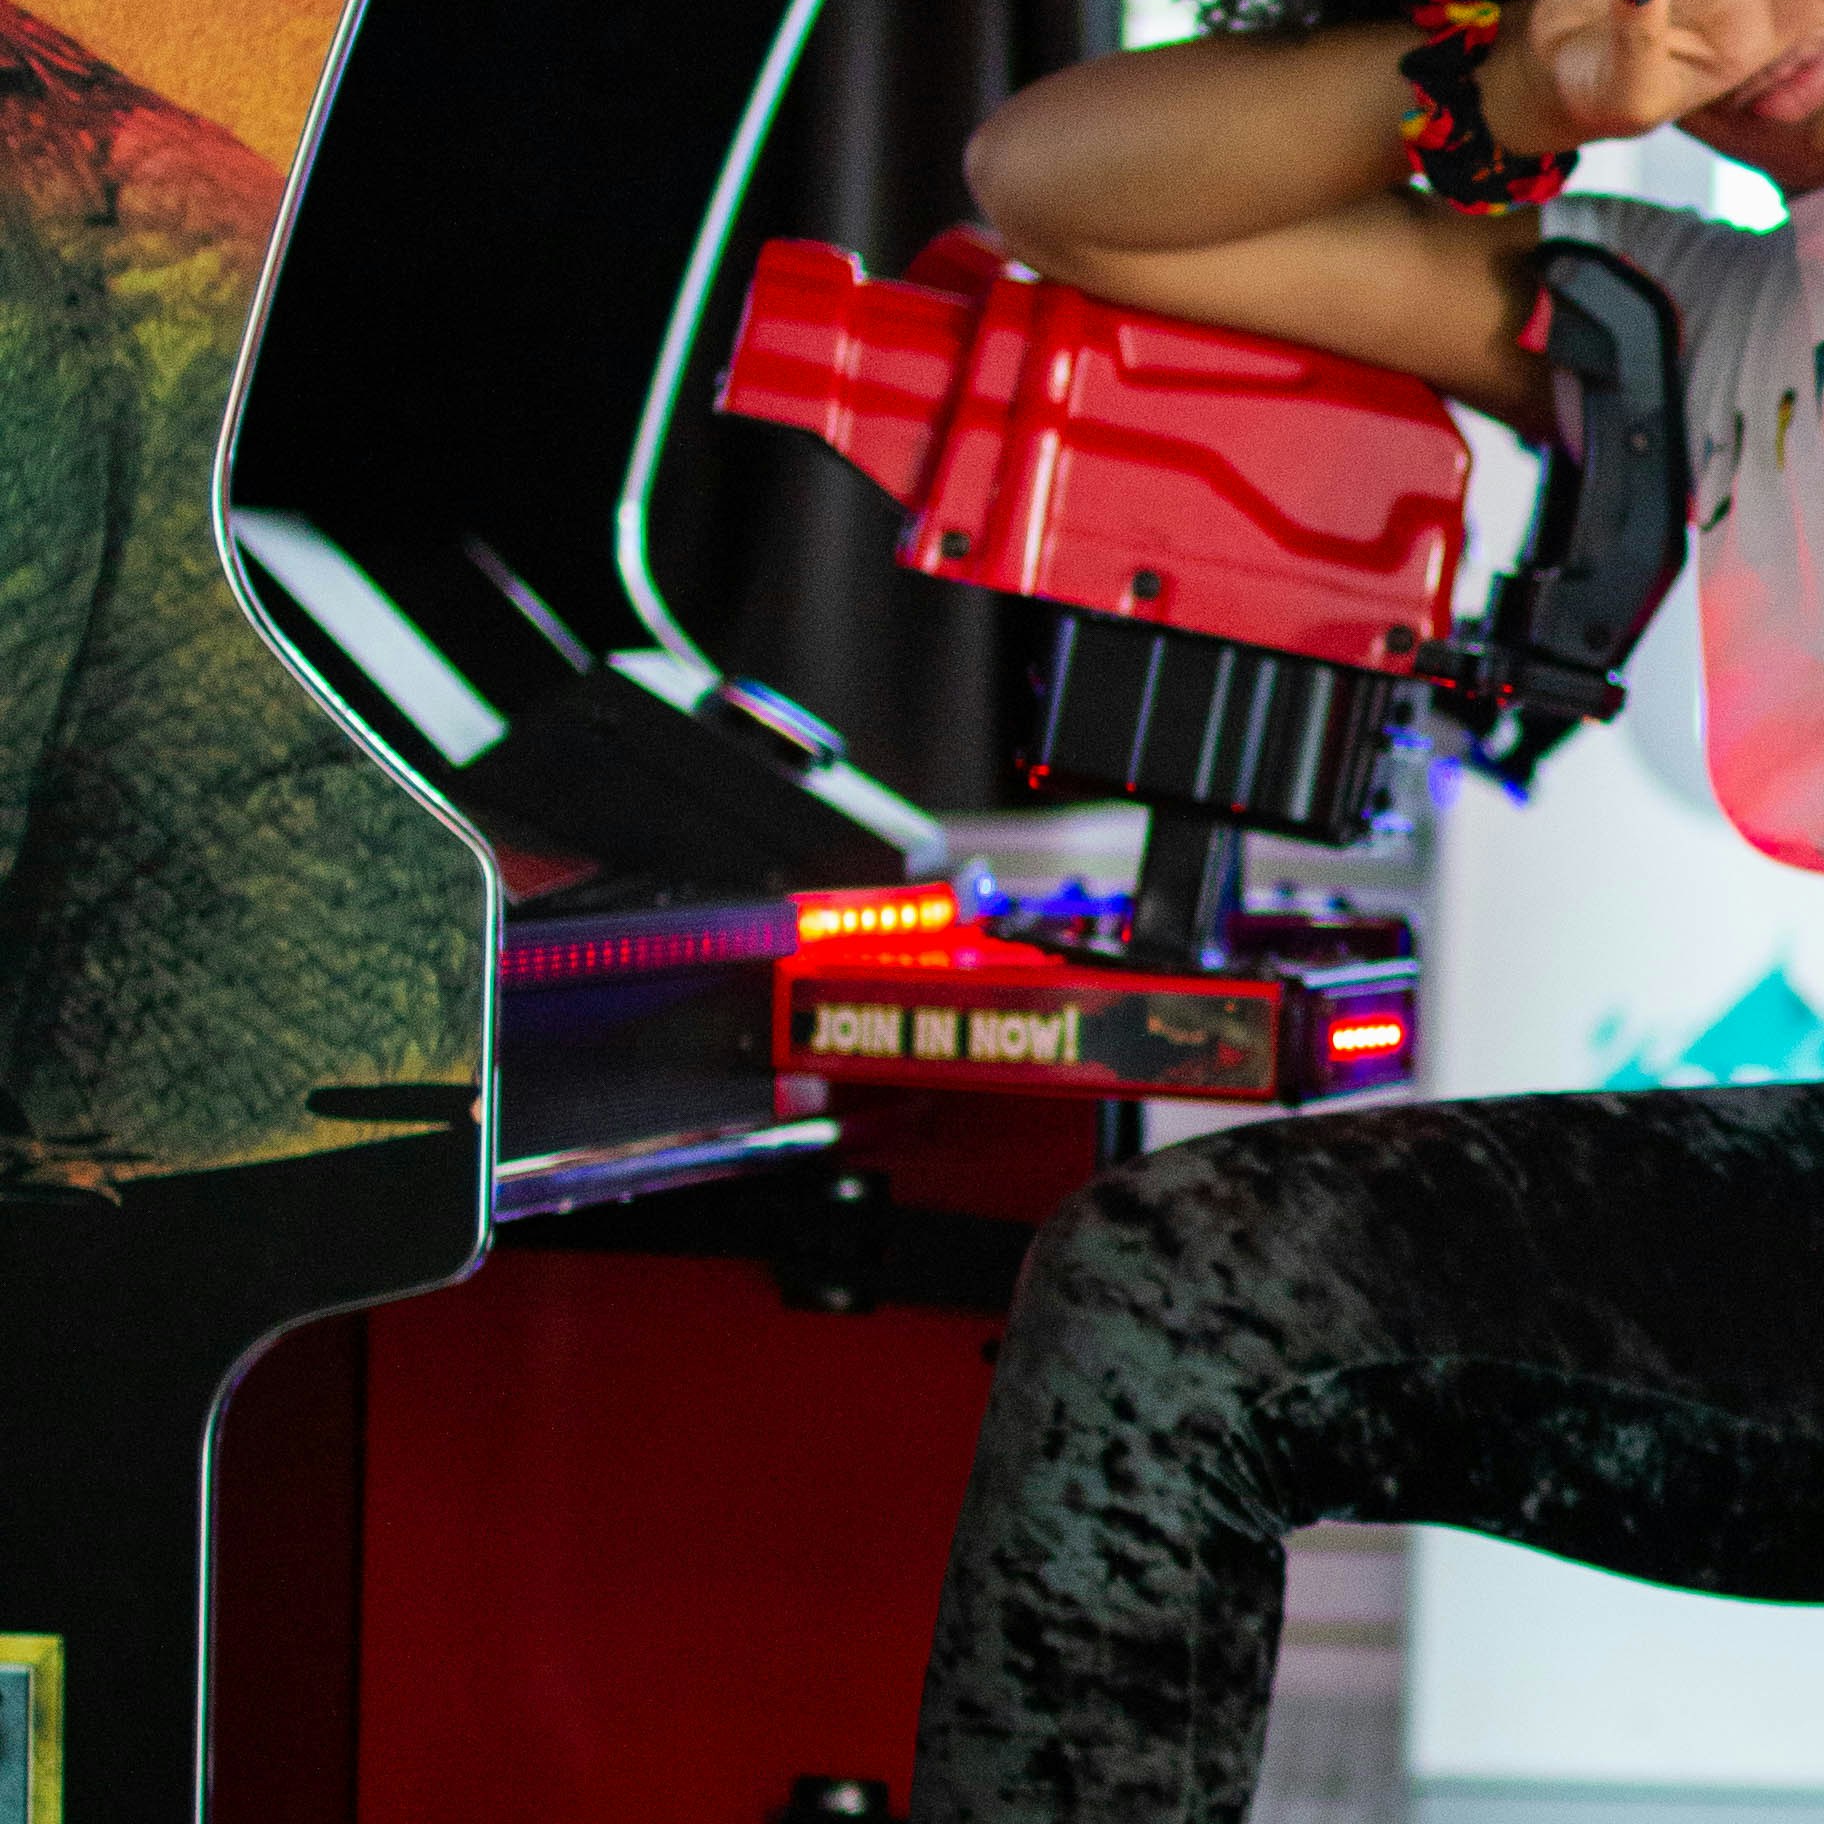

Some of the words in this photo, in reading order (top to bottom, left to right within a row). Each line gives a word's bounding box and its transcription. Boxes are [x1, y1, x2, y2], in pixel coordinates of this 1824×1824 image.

[812, 1003, 901, 1056] JOIN
[913, 1007, 959, 1058] IN
[969, 1003, 1080, 1064] NOW!
